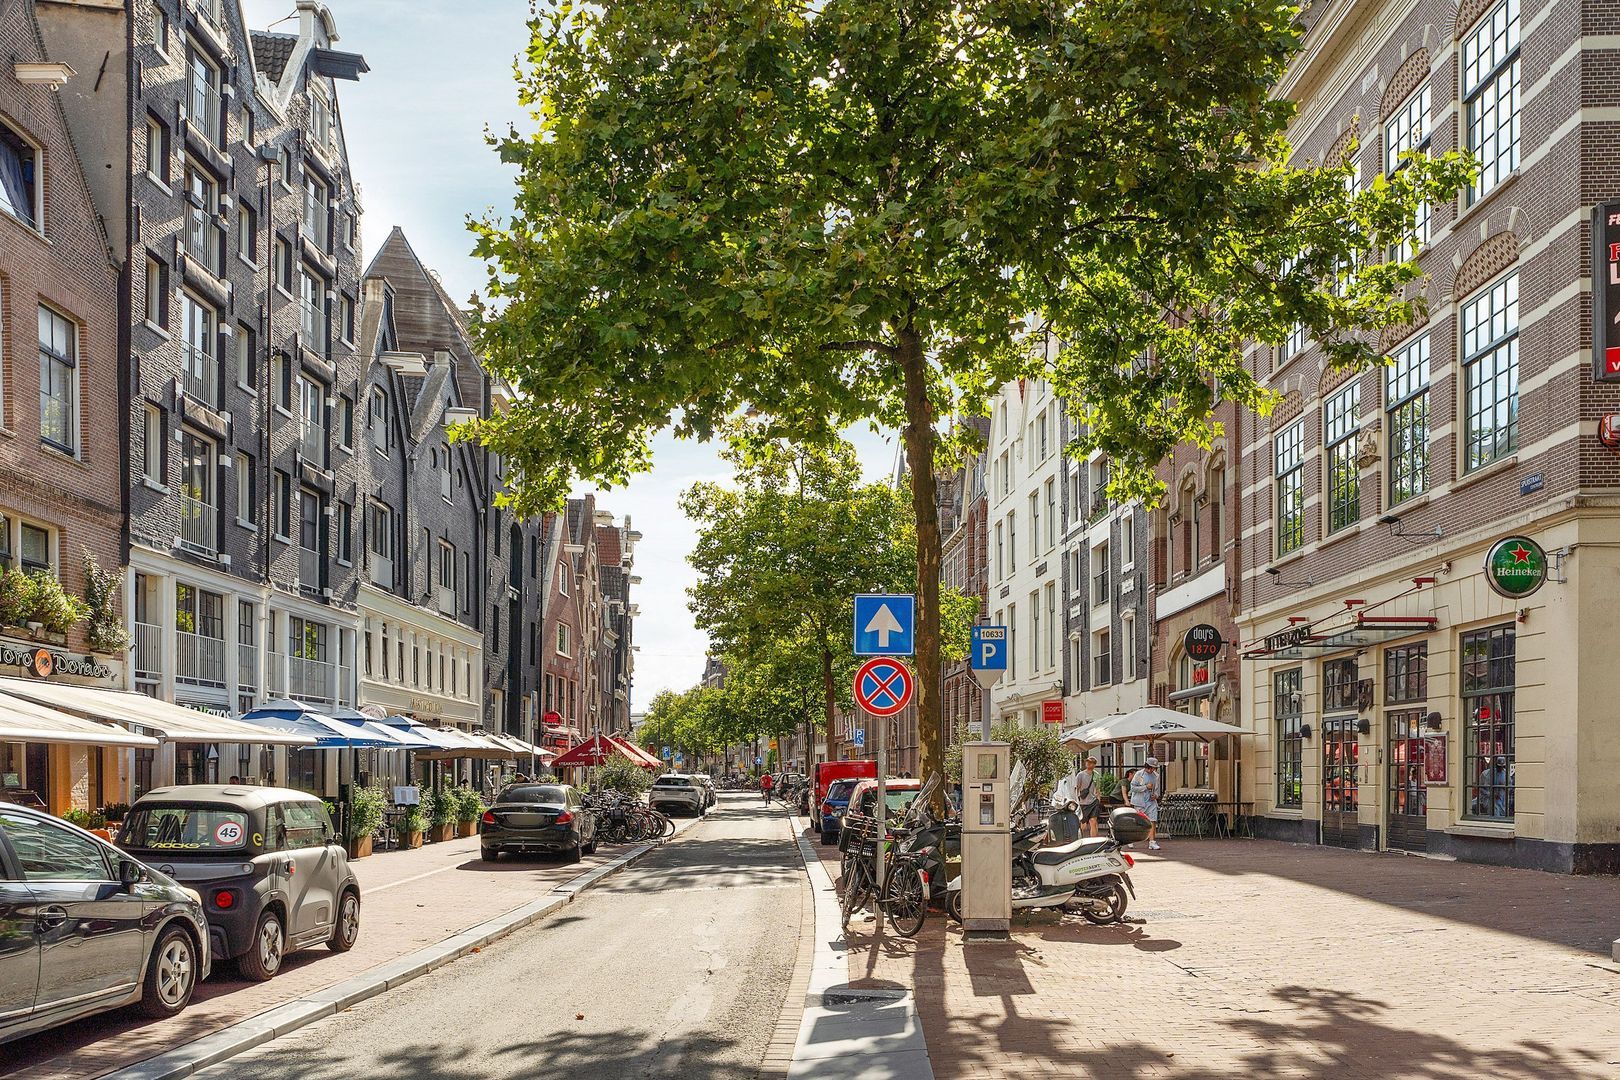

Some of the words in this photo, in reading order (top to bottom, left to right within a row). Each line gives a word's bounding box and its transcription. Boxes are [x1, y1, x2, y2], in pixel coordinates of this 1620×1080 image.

[1497, 567, 1541, 576] Heineken
[982, 630, 1004, 638] 10633
[982, 643, 997, 666] P
[1191, 644, 1217, 655] 1870
[220, 827, 239, 838] 45
